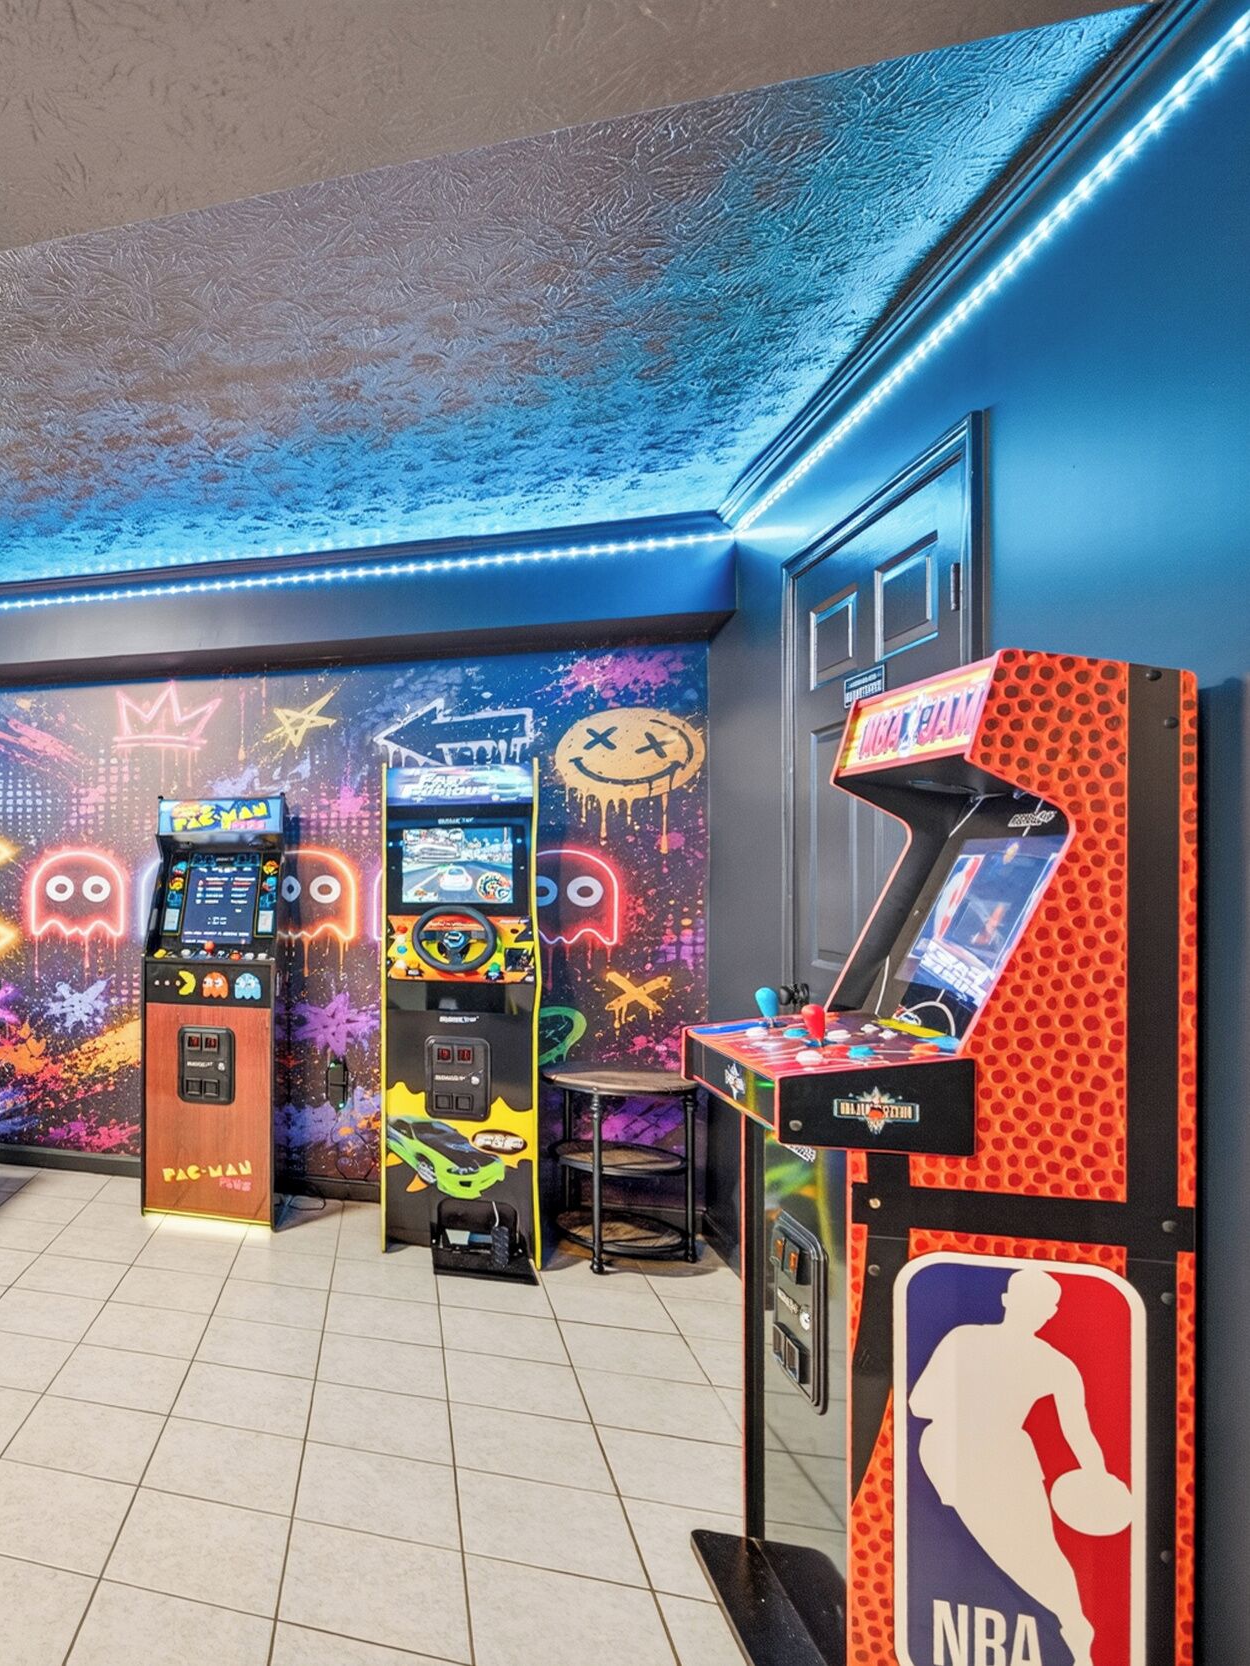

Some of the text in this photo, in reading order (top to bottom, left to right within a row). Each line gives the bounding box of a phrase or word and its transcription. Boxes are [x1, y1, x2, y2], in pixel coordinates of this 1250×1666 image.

[859, 682, 986, 760] NBA JAM
[173, 801, 268, 831] PAC-MAN
[162, 1159, 252, 1183] PAC-MAN
[933, 1599, 1042, 1666] NBA
